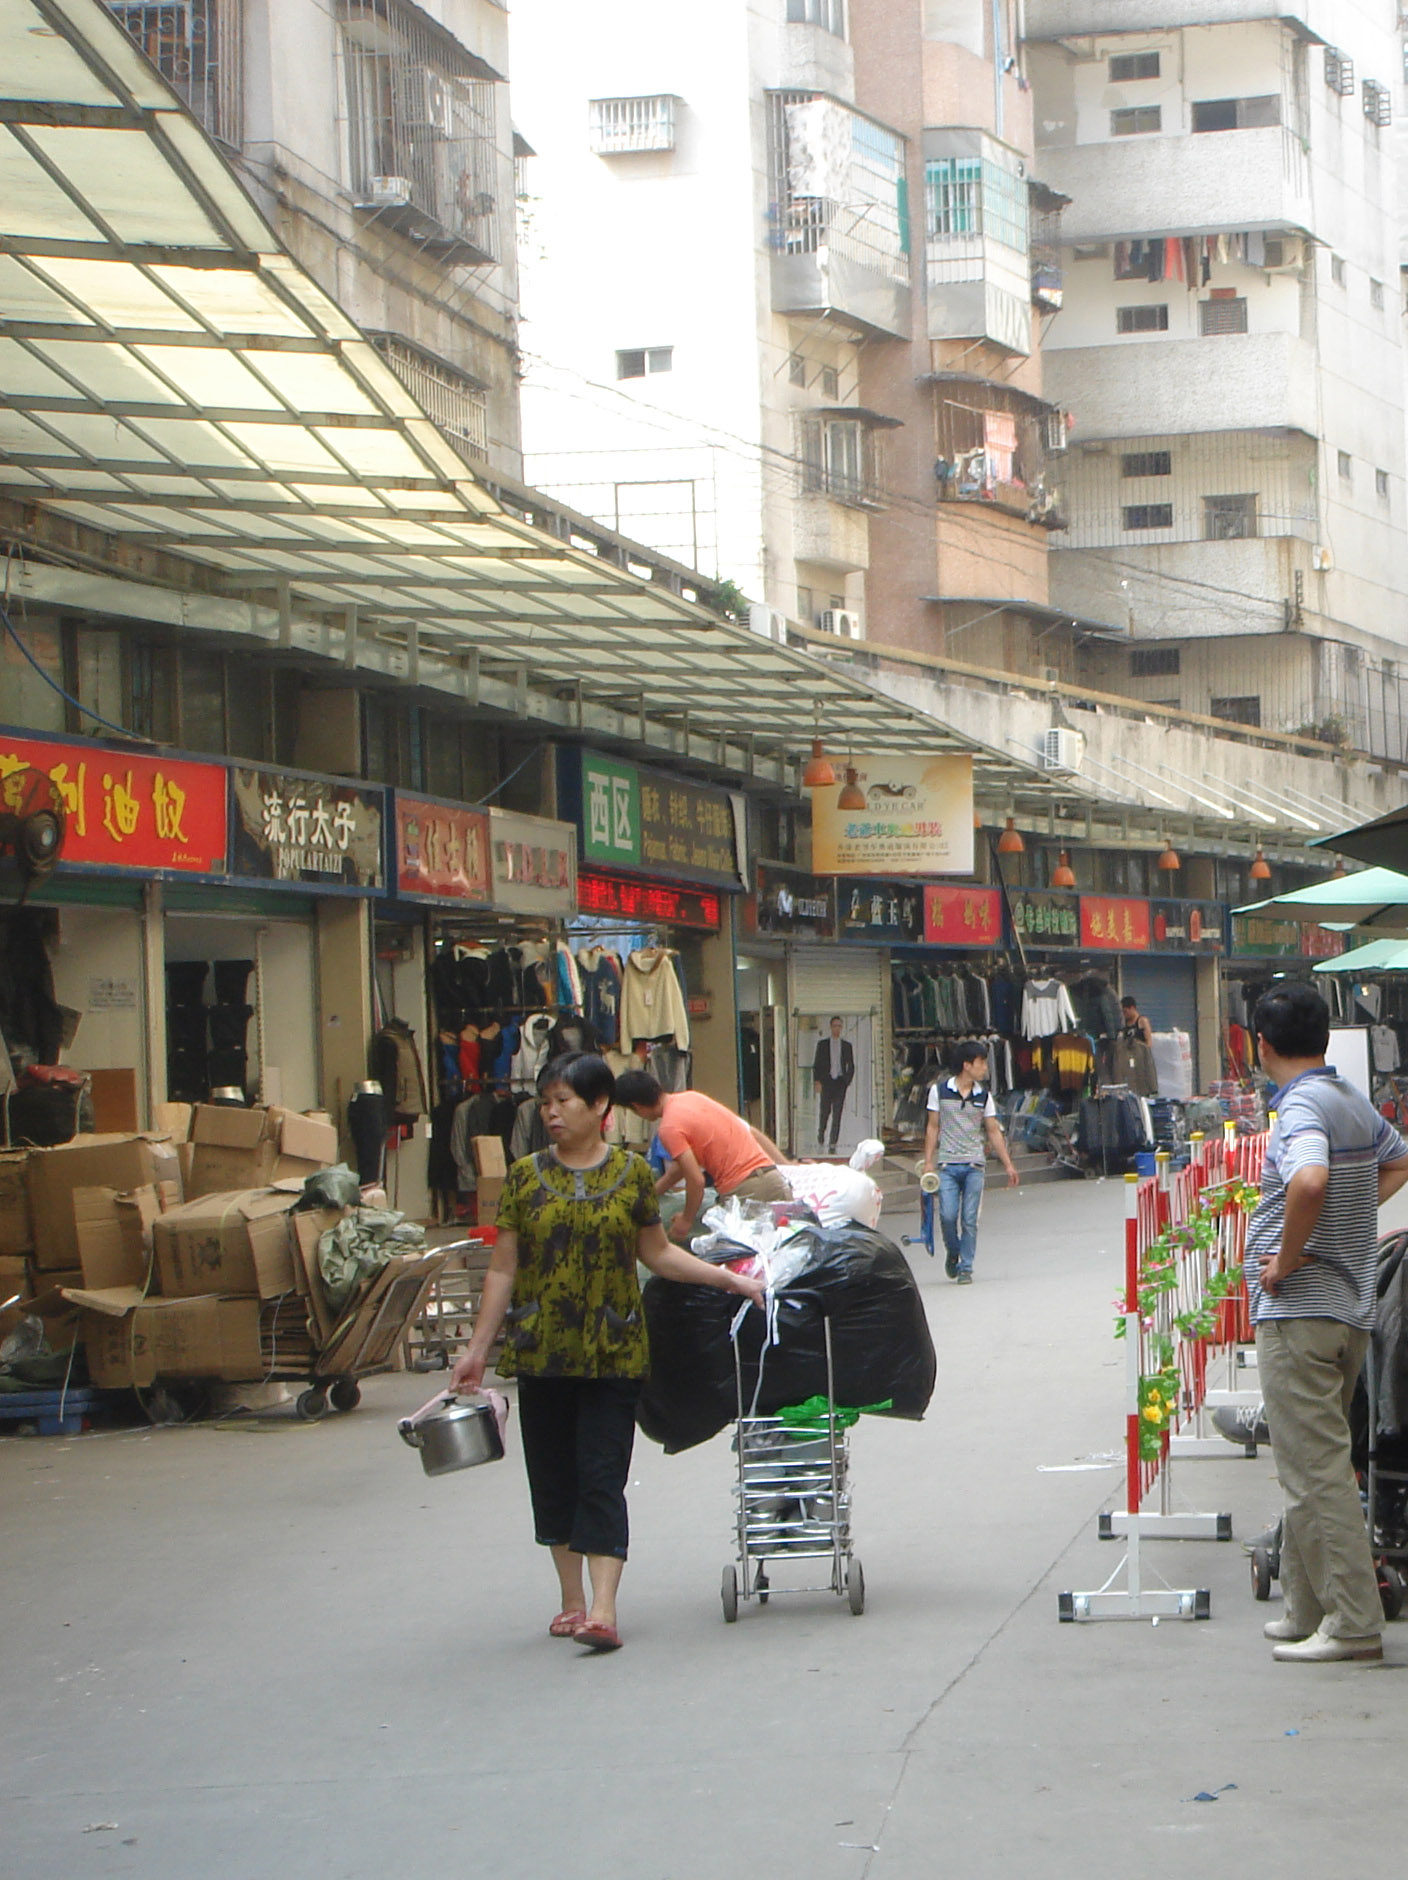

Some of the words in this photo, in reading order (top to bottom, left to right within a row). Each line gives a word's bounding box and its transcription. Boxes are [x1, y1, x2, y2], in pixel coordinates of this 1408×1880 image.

[263, 789, 356, 850] 流行太子
[587, 770, 634, 852] 西区
